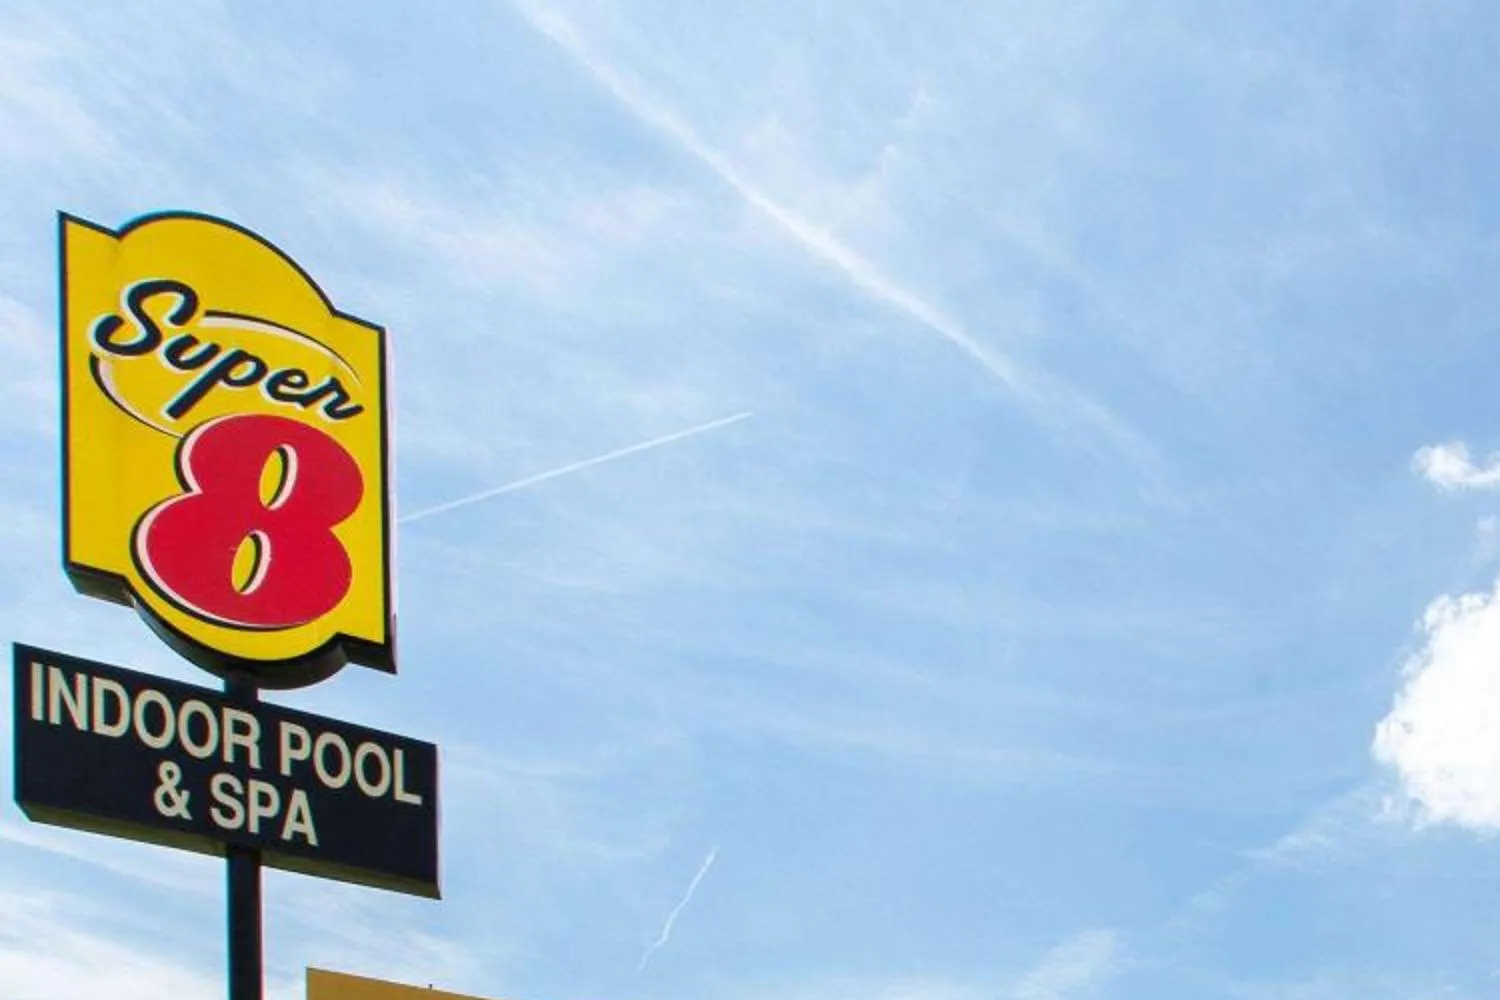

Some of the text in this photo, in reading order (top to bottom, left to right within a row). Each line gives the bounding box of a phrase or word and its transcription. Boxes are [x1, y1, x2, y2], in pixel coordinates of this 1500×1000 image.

[92, 278, 364, 420] Super
[130, 412, 364, 630] 8
[31, 662, 423, 806] INDOOR POOL
[153, 760, 319, 847] & SPA
